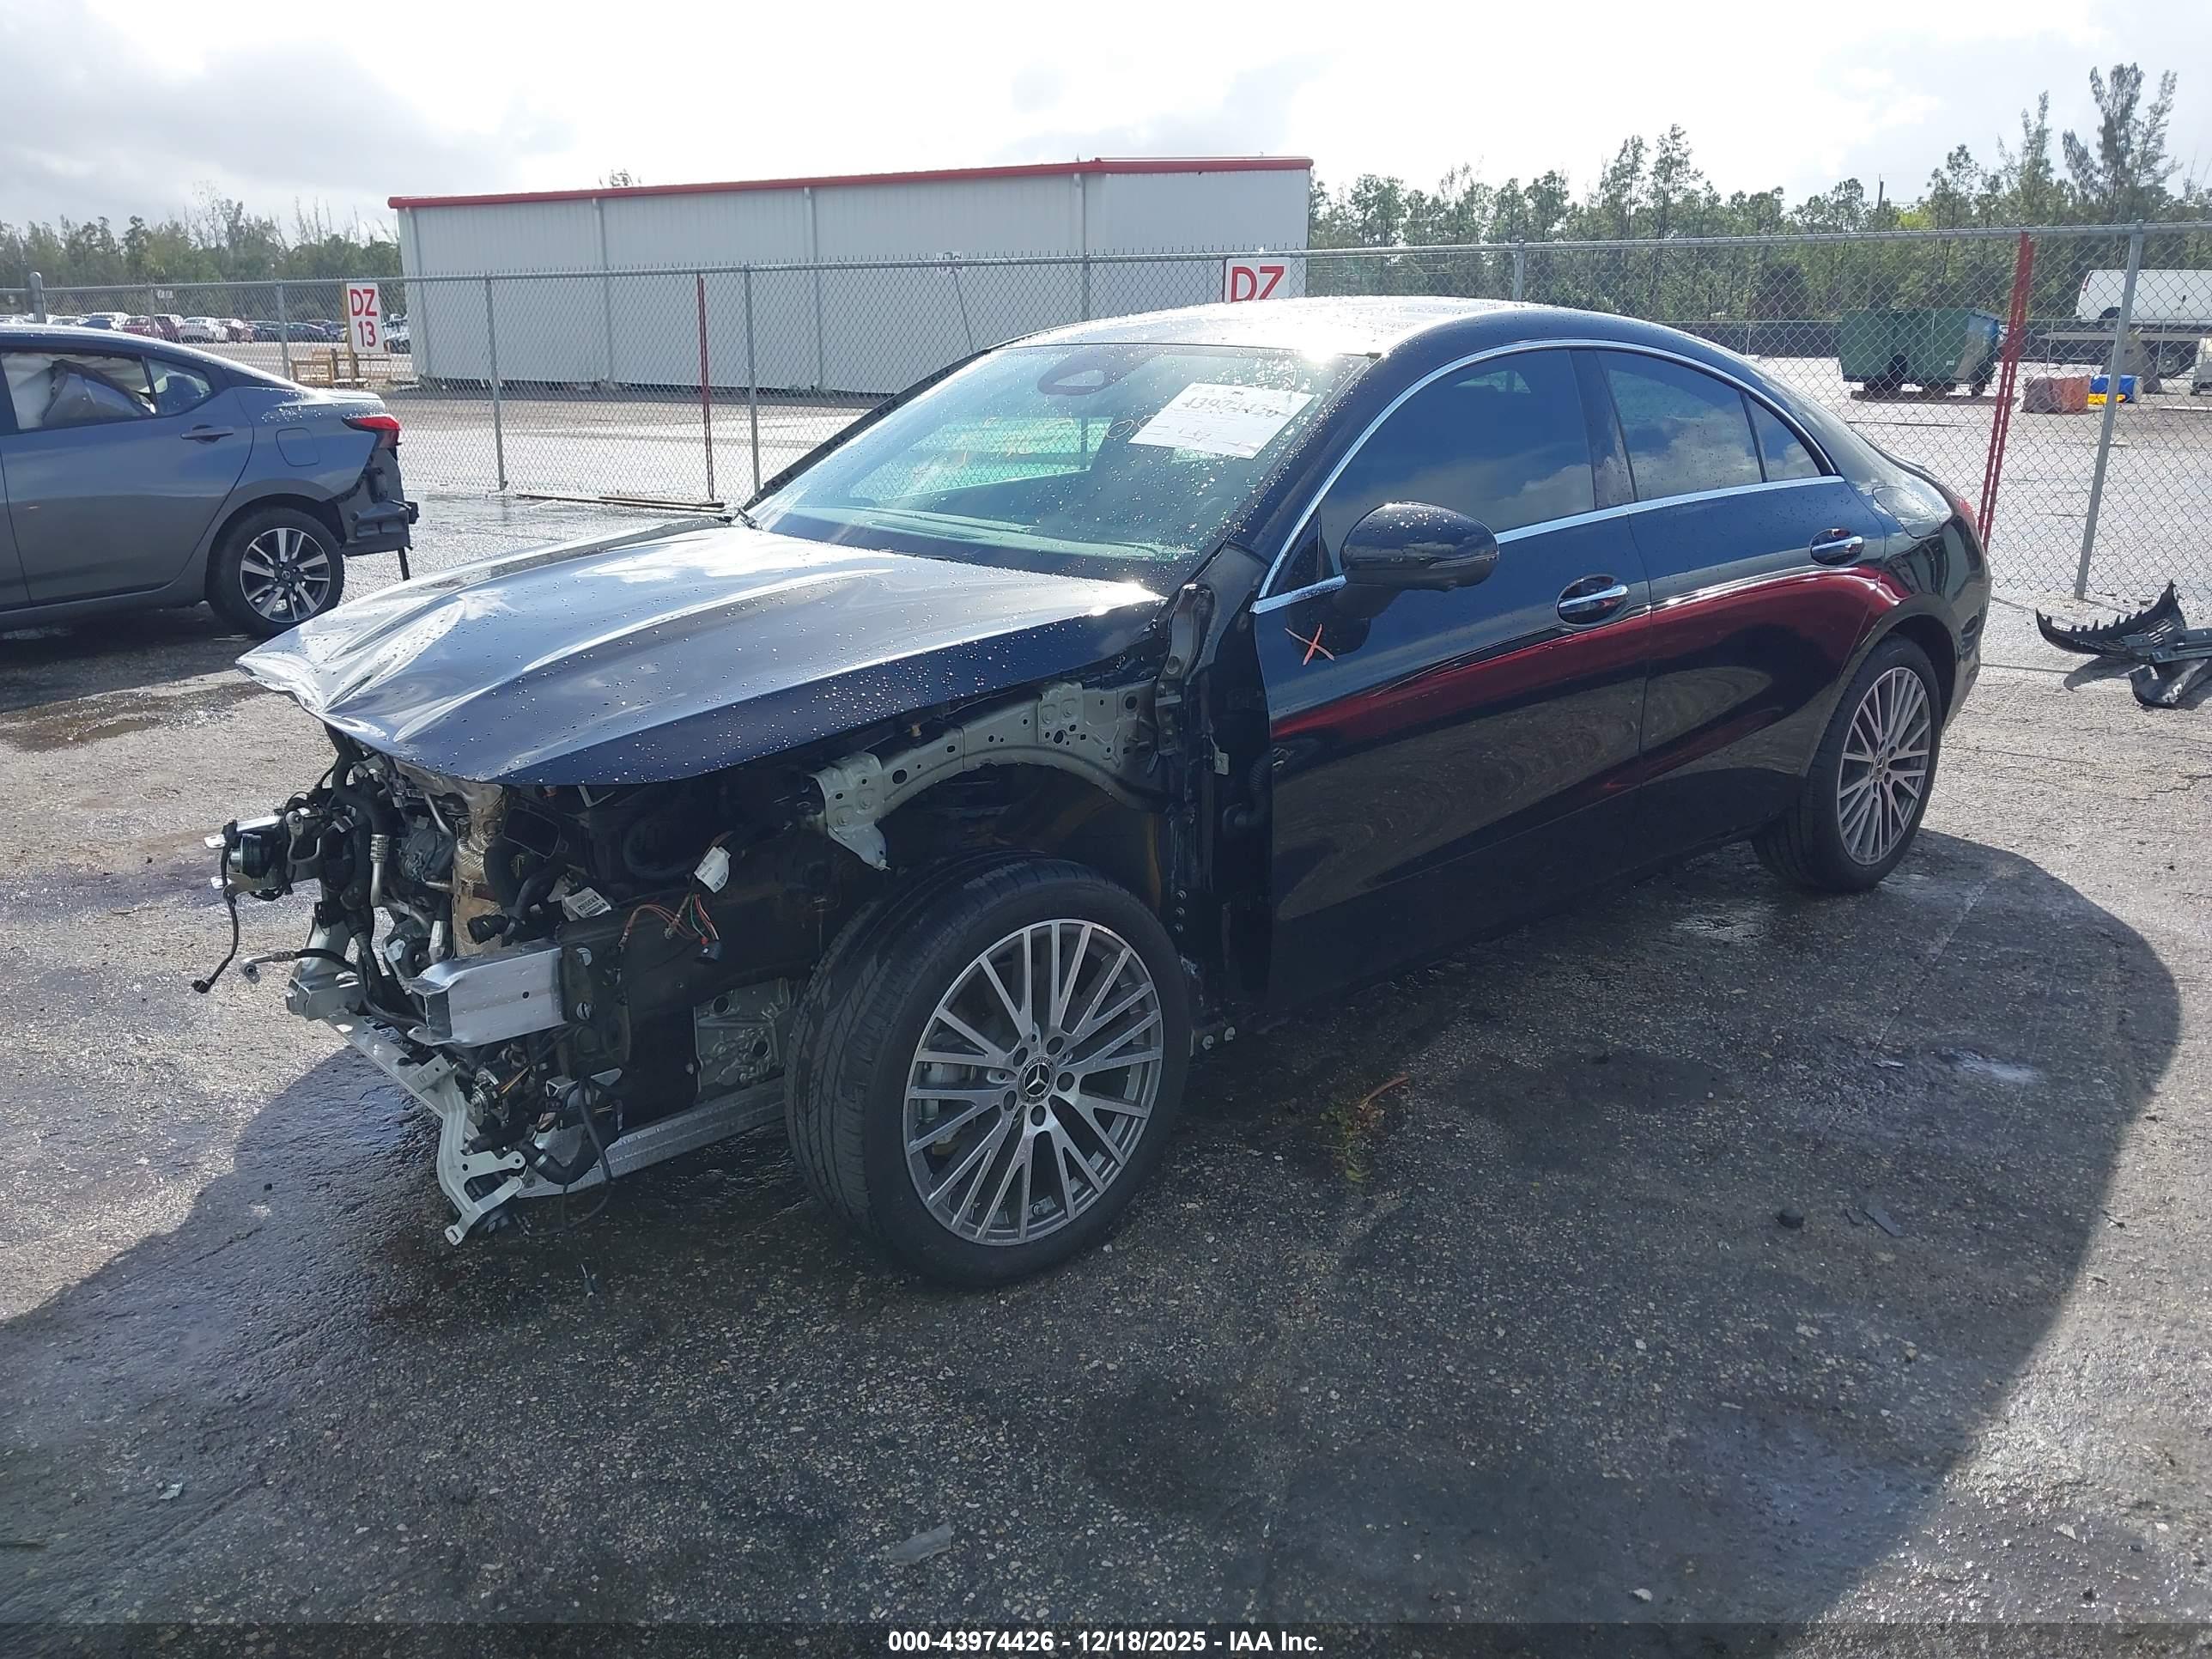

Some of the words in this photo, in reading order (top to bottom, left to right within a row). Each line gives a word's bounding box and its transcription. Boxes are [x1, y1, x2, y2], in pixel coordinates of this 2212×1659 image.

[1231, 265, 1285, 302] DZ
[349, 289, 378, 317] DZ
[357, 320, 377, 348] 13
